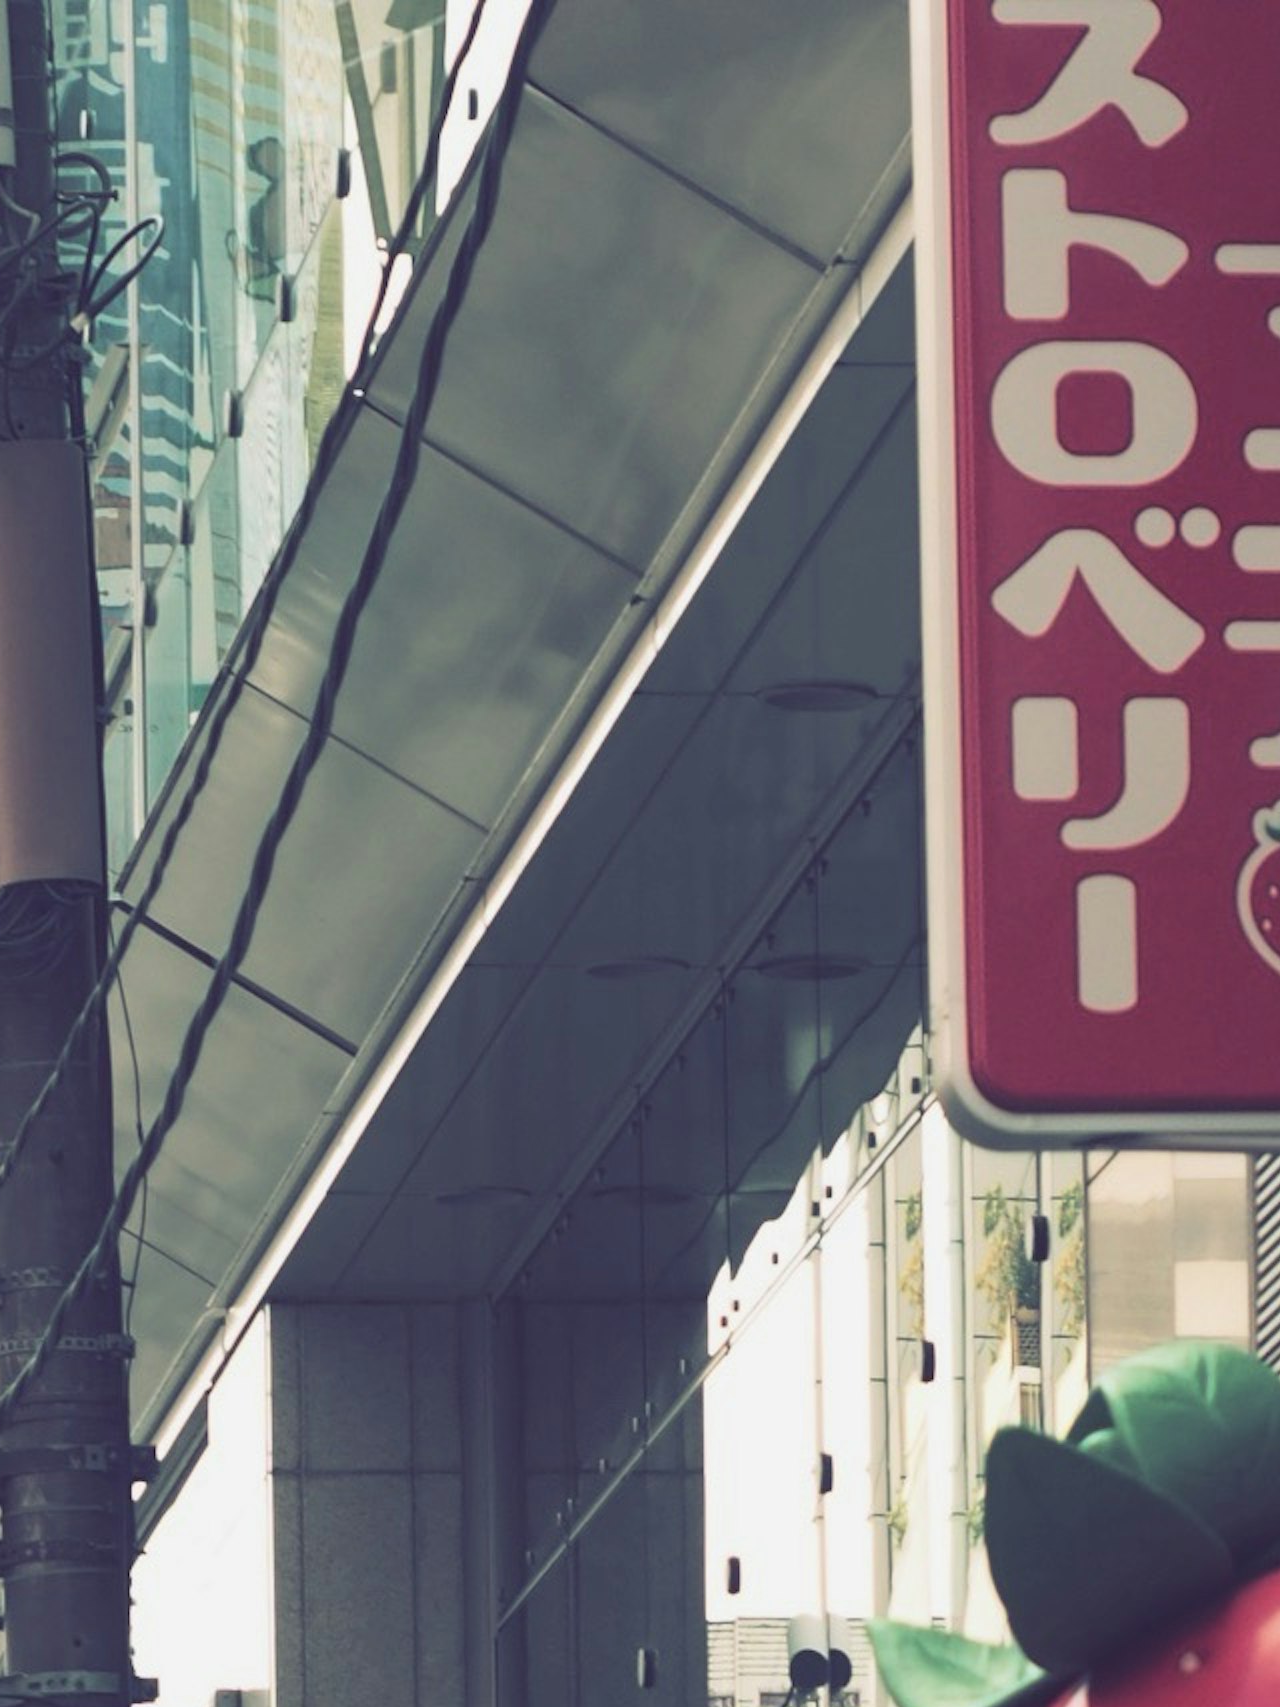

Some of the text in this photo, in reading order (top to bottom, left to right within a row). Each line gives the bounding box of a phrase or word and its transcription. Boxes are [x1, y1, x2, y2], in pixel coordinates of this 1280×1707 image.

[989, 0, 1221, 1012] ストロベリー
